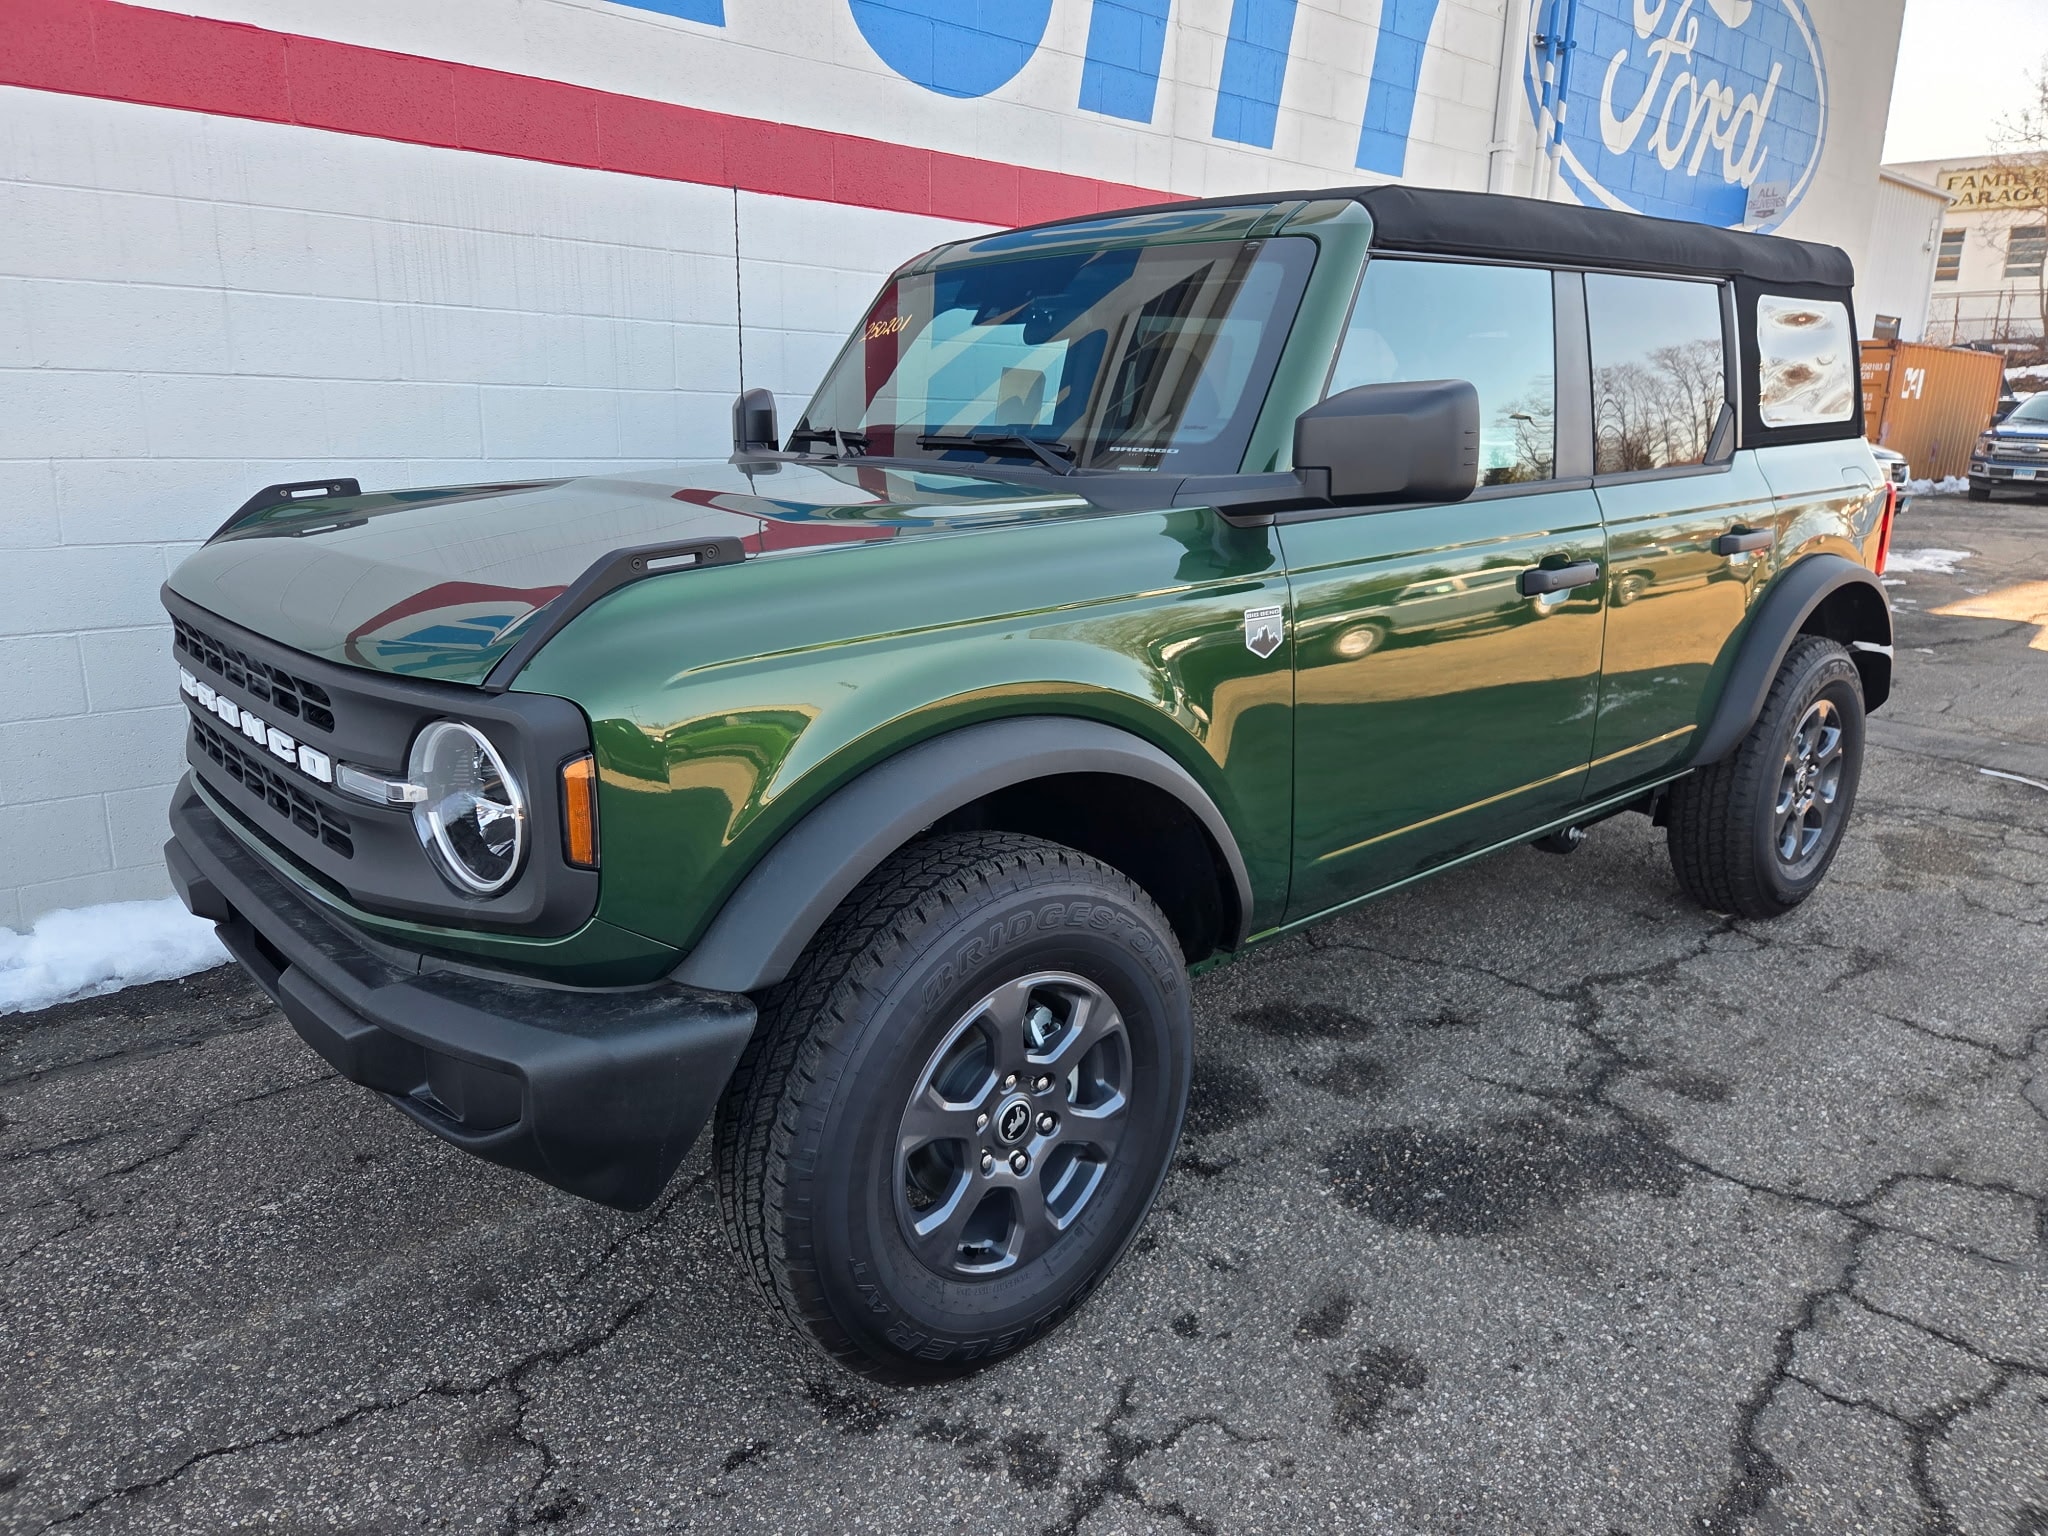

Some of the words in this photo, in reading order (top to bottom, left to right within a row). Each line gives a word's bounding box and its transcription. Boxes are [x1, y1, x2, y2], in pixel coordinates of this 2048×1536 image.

[1600, 0, 1782, 189] Ford
[1758, 187, 1778, 198] ALL
[1109, 446, 1179, 454] BRONCO
[1260, 608, 1280, 617] BEND
[180, 667, 333, 784] BRONCO
[922, 901, 1179, 1013] BRIDGESTONE
